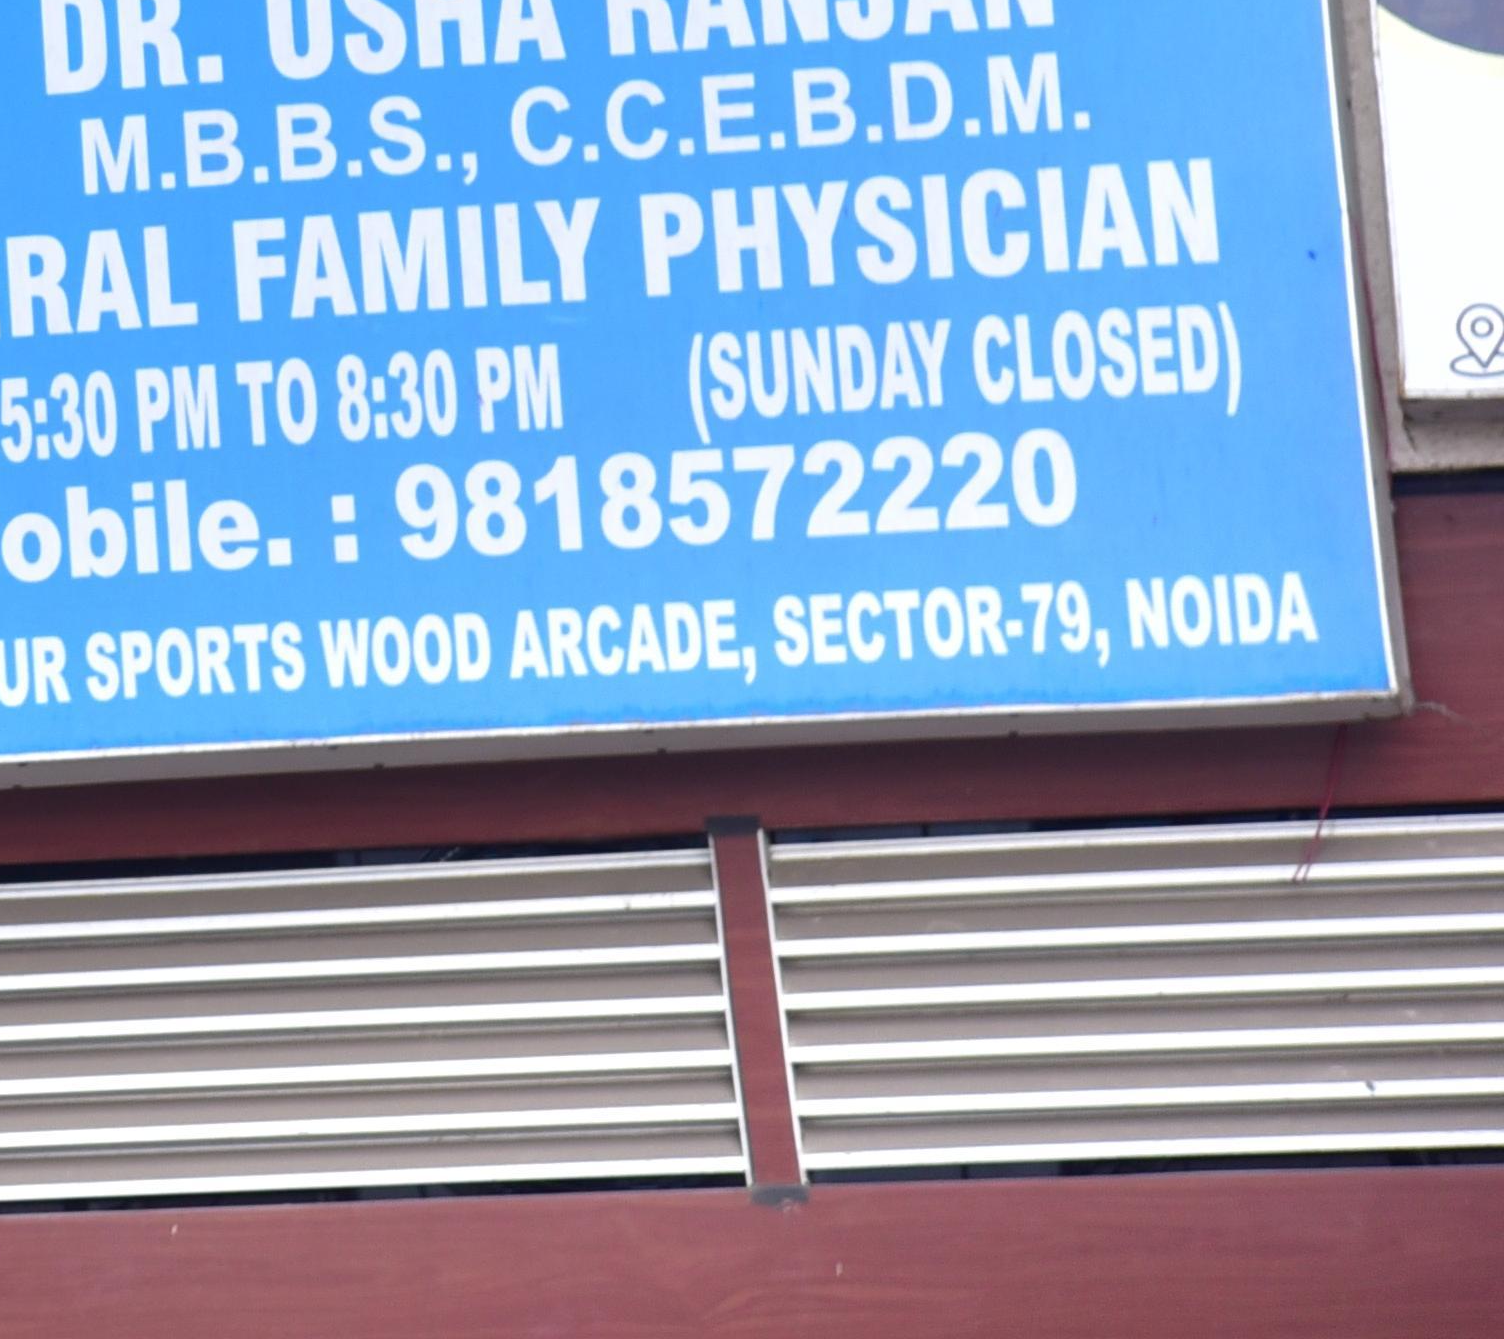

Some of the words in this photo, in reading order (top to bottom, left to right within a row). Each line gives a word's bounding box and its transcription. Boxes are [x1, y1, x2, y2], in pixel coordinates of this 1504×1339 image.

[81, 95, 477, 196] M.B.B.S.,
[511, 52, 1090, 166] C.C.E.B.D.M.
[233, 197, 600, 323] FAMILY
[640, 157, 1219, 298] PHYSICIAN
[1, 370, 117, 463] 5:30
[136, 364, 220, 453] PM
[236, 357, 317, 446] TO
[337, 349, 457, 442] 8:30
[476, 343, 563, 433] PM
[689, 318, 950, 444] (SUNDAY
[973, 303, 1241, 415] CLOSED)
[395, 428, 1077, 560] 9818572220
[86, 621, 305, 702] SPORTS
[319, 612, 490, 688] WOOD
[510, 600, 756, 680] ARCADE,
[774, 580, 1109, 667] SECTOR-79,
[1126, 571, 1319, 649] NOIDA
